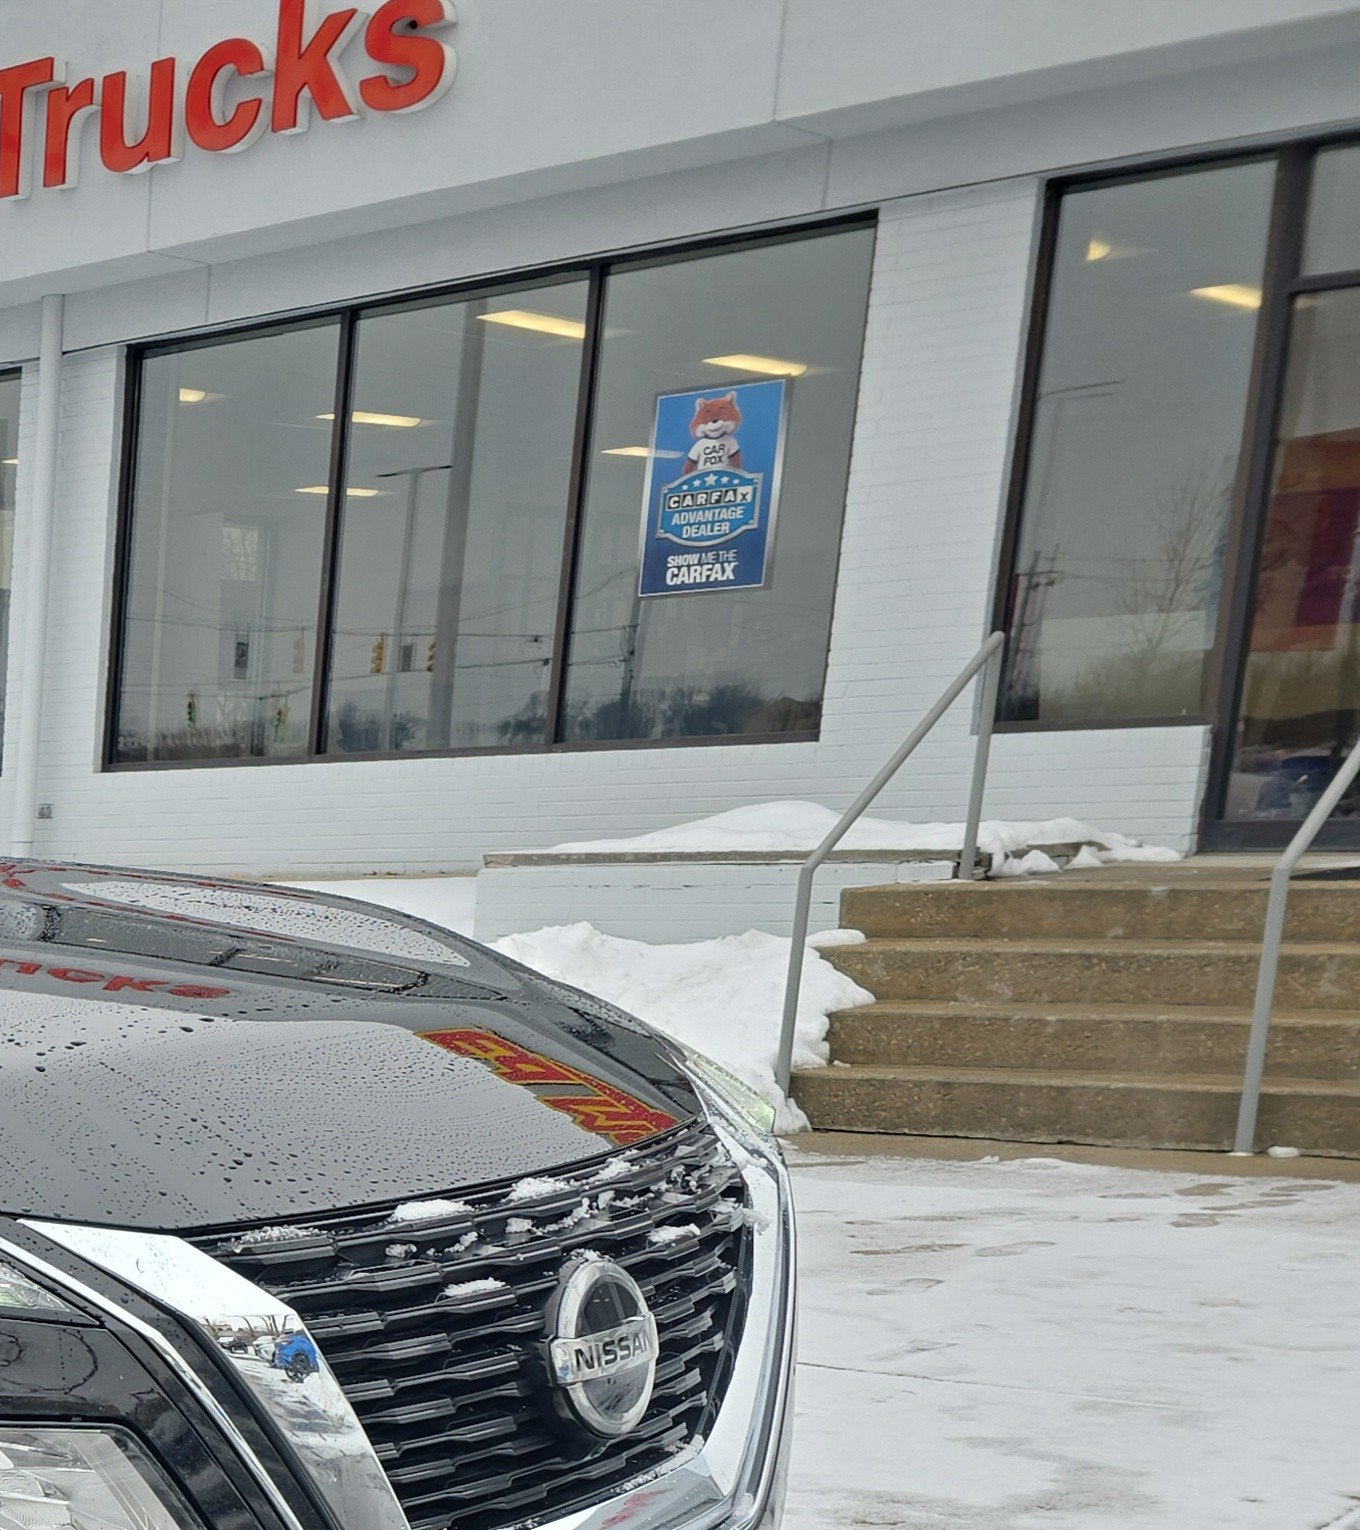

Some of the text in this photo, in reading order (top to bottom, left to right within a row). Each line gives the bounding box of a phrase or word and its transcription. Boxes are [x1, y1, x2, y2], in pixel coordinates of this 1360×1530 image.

[703, 443, 725, 456] CAR
[703, 455, 724, 467] FOX
[667, 487, 751, 509] CARFAX
[671, 505, 746, 526] ADVANTAGE
[682, 521, 731, 539] DEALER
[666, 549, 739, 567] SHOW ME THE
[665, 561, 738, 586] CARFAX
[573, 1330, 653, 1371] NISSAN
